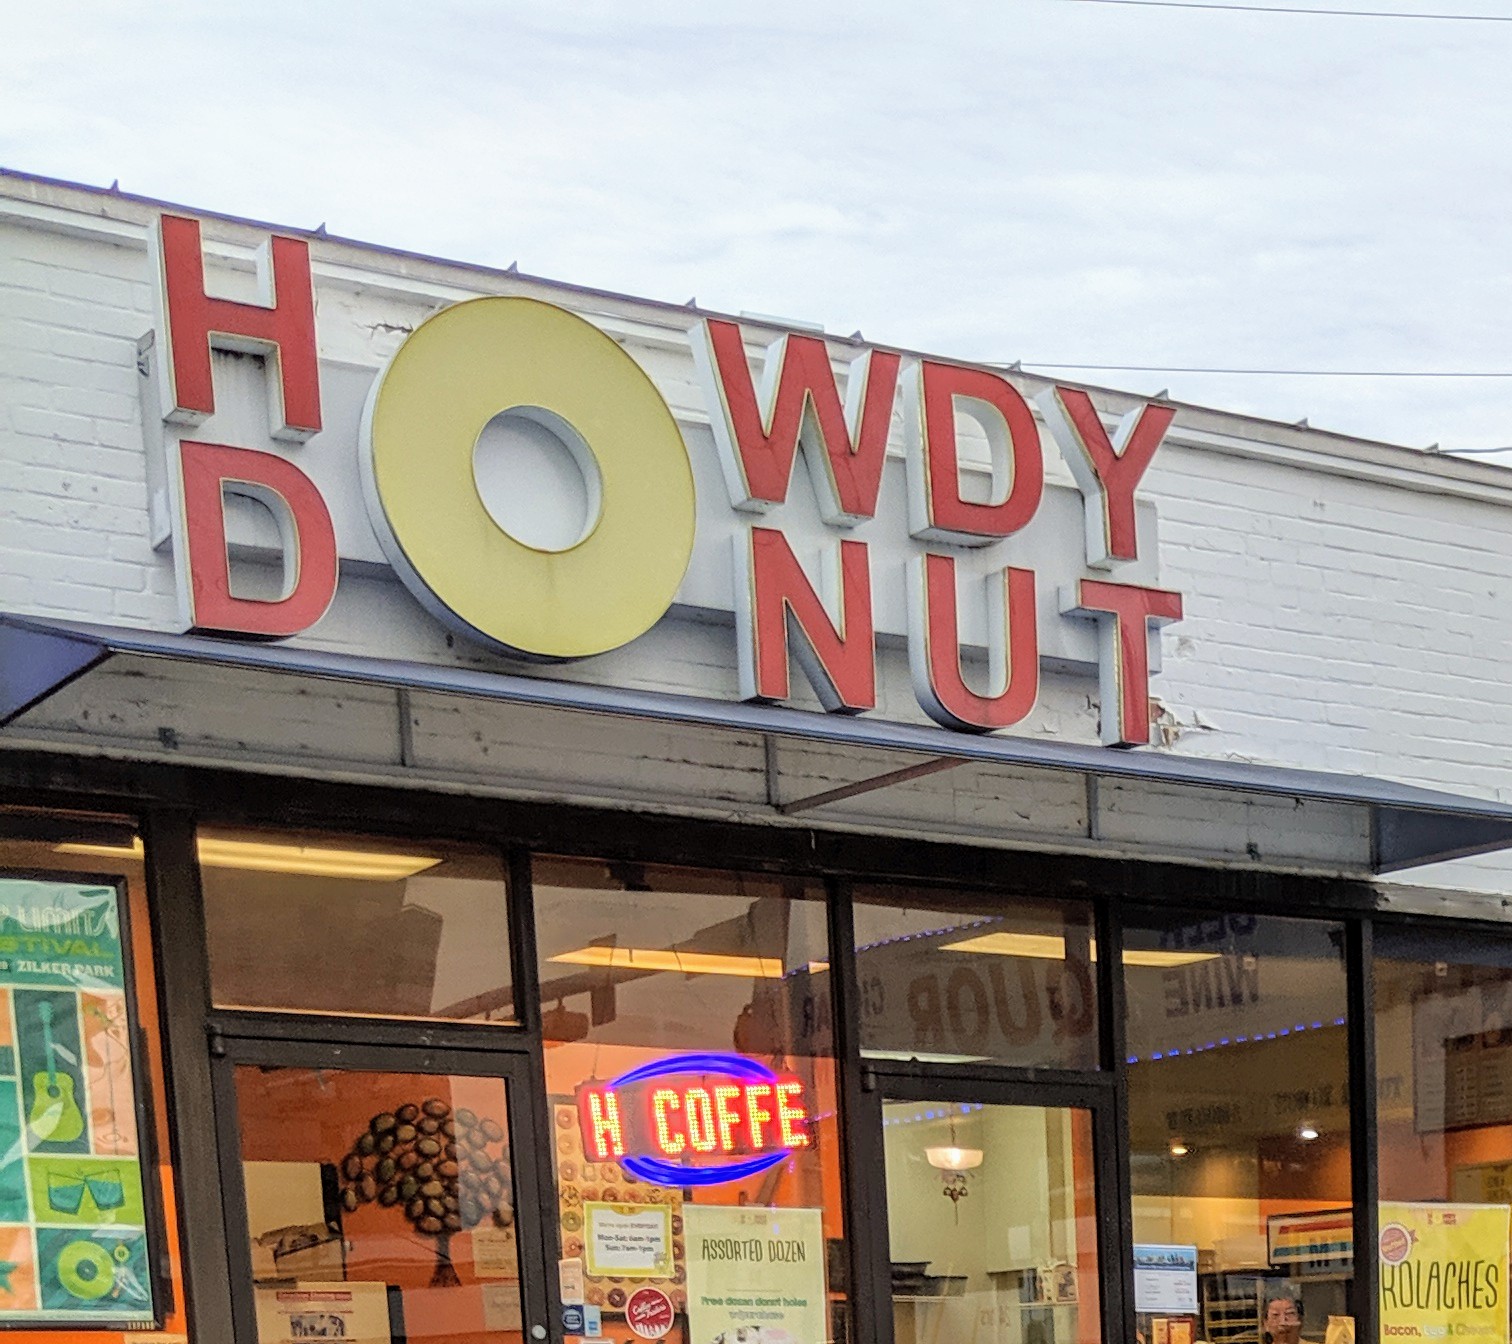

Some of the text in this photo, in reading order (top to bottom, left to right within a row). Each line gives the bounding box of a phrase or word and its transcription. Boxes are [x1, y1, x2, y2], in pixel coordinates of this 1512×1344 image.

[158, 213, 1178, 657] HOWDY
[178, 296, 1184, 748] DONUT
[17, 960, 71, 975] ZILKER
[73, 963, 114, 977] PARK
[653, 1083, 810, 1155] COFFE
[702, 1238, 806, 1263] ASSORTED DOZEN
[1381, 1259, 1499, 1311] KOLACHES
